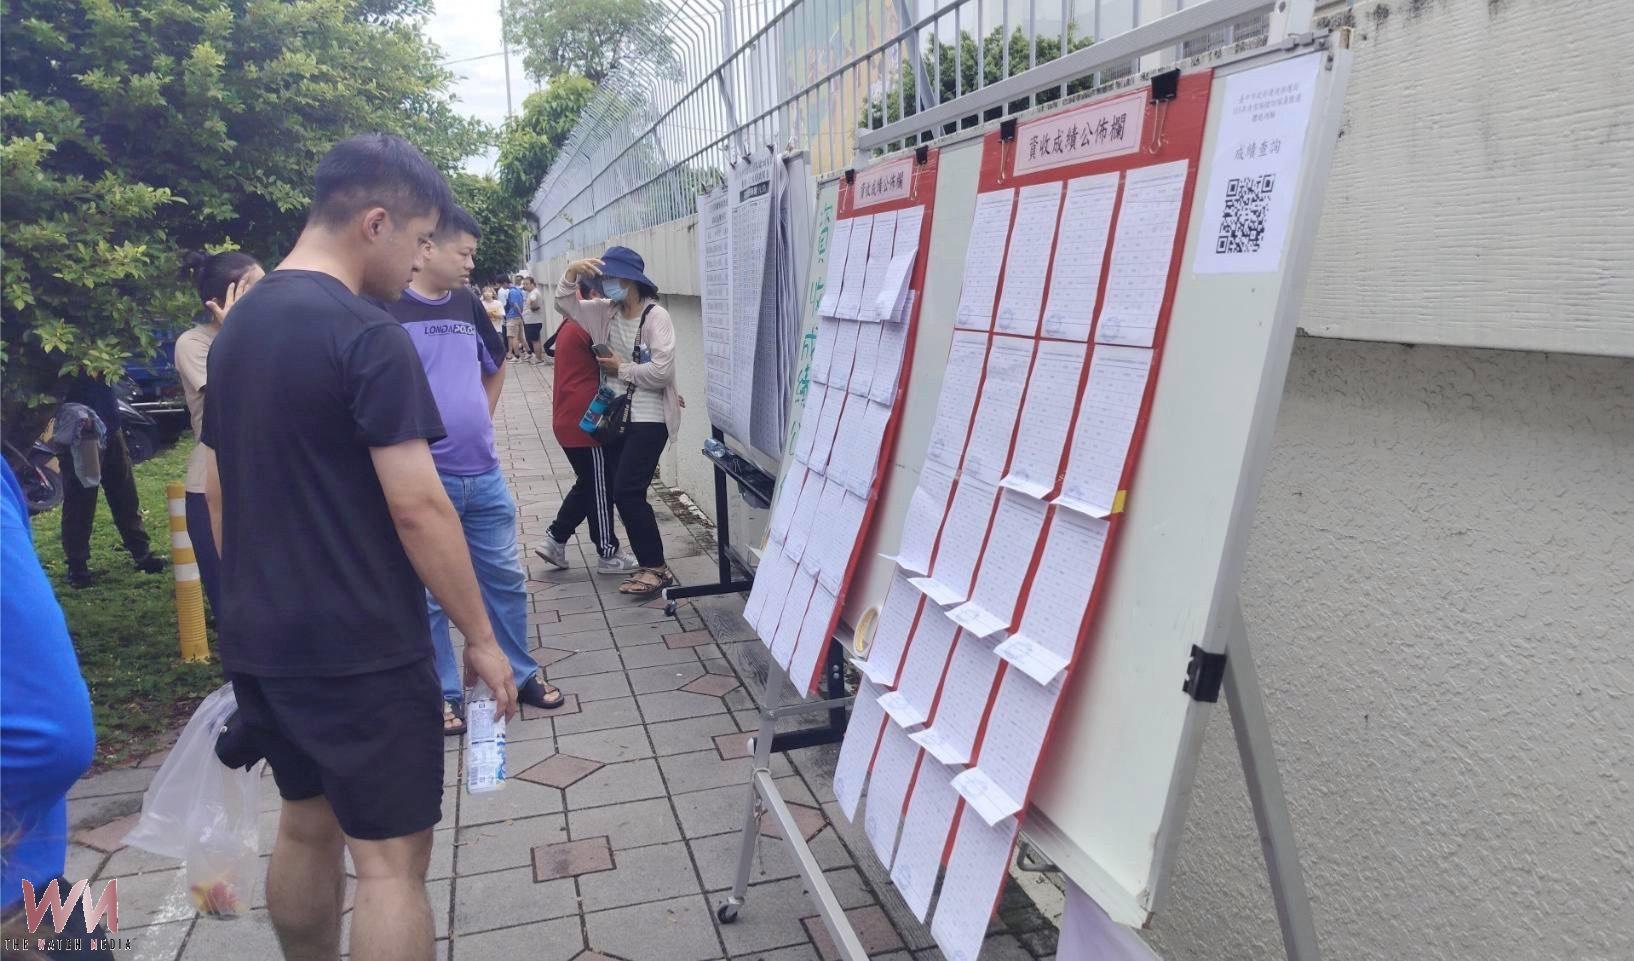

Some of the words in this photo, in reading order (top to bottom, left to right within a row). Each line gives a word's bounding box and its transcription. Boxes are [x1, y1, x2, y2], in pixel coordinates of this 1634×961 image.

[1028, 112, 1127, 161] 資收成績公佈欄
[1234, 138, 1282, 160] 成績查詢
